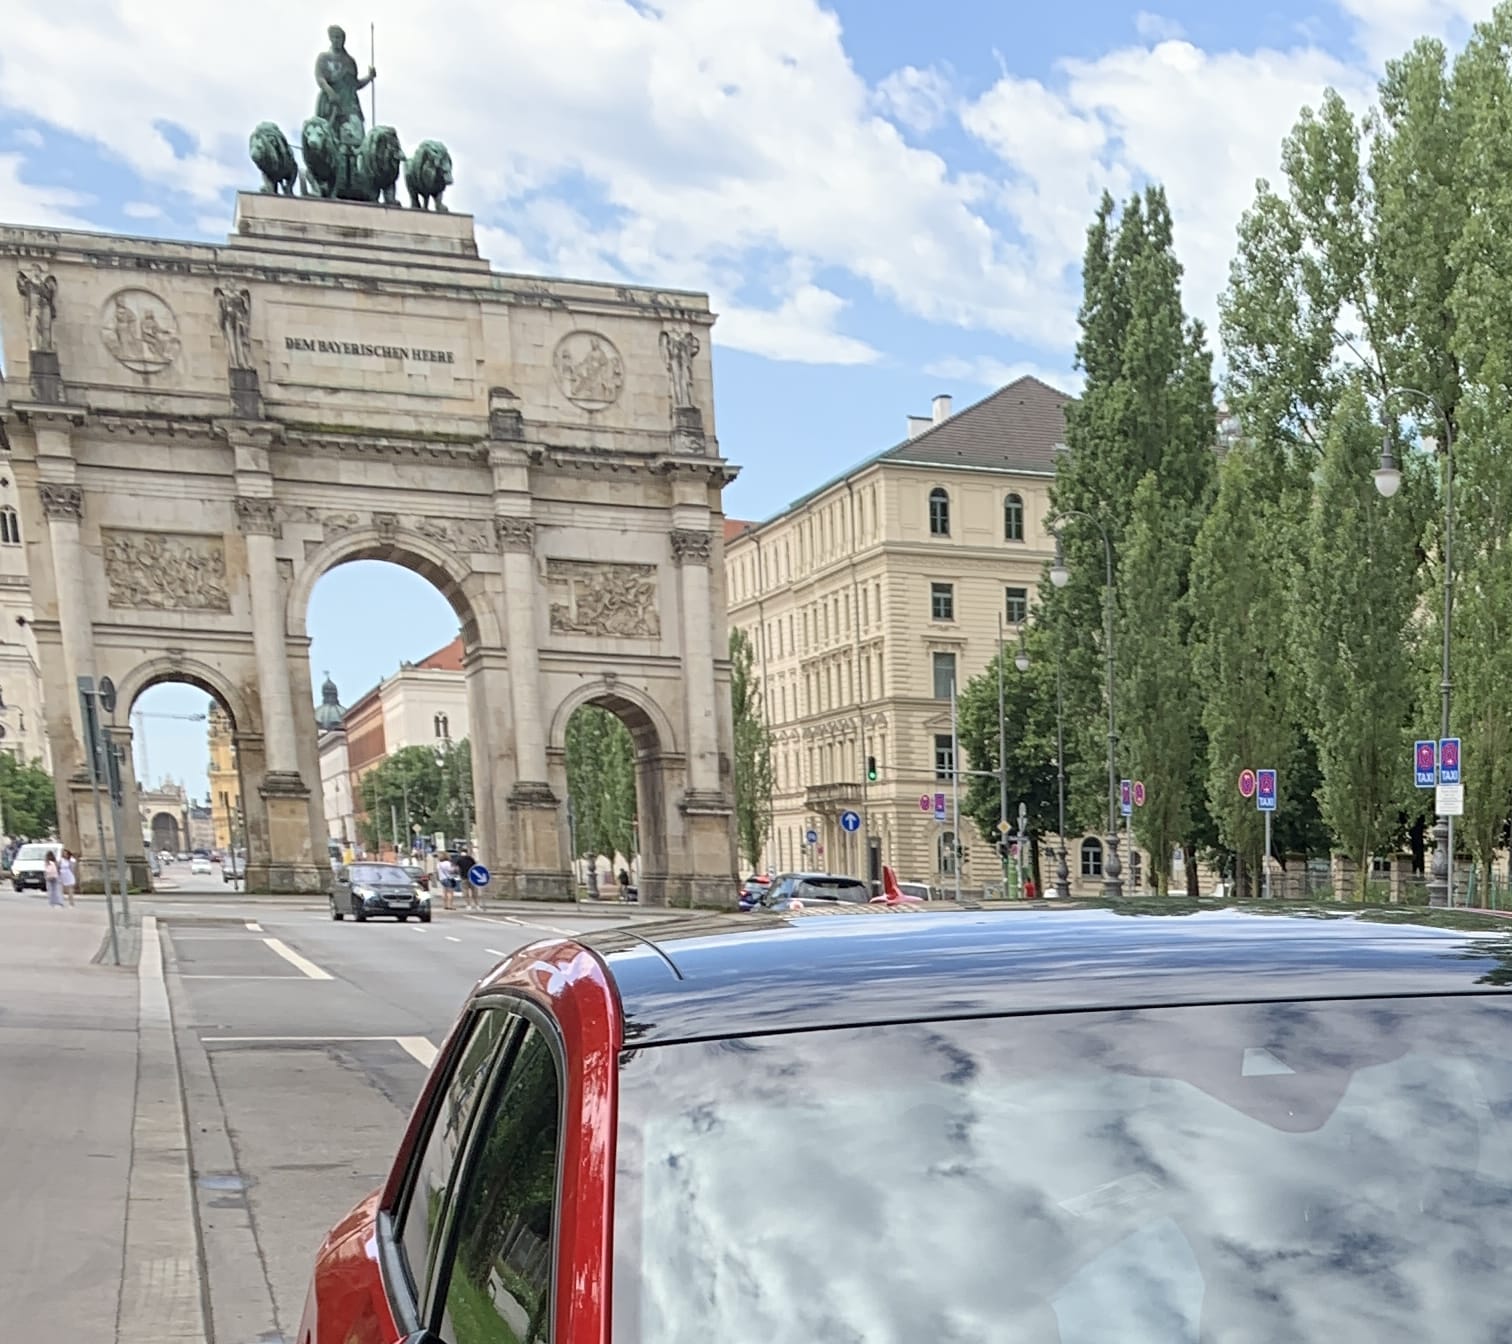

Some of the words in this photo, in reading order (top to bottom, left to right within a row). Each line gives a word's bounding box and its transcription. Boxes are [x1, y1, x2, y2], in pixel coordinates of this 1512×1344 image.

[284, 336, 315, 352] DEM
[317, 339, 410, 360] BAYERISCHEN
[411, 348, 455, 364] HEERE
[1417, 772, 1434, 783] TAXI
[1442, 770, 1458, 780] TAXI
